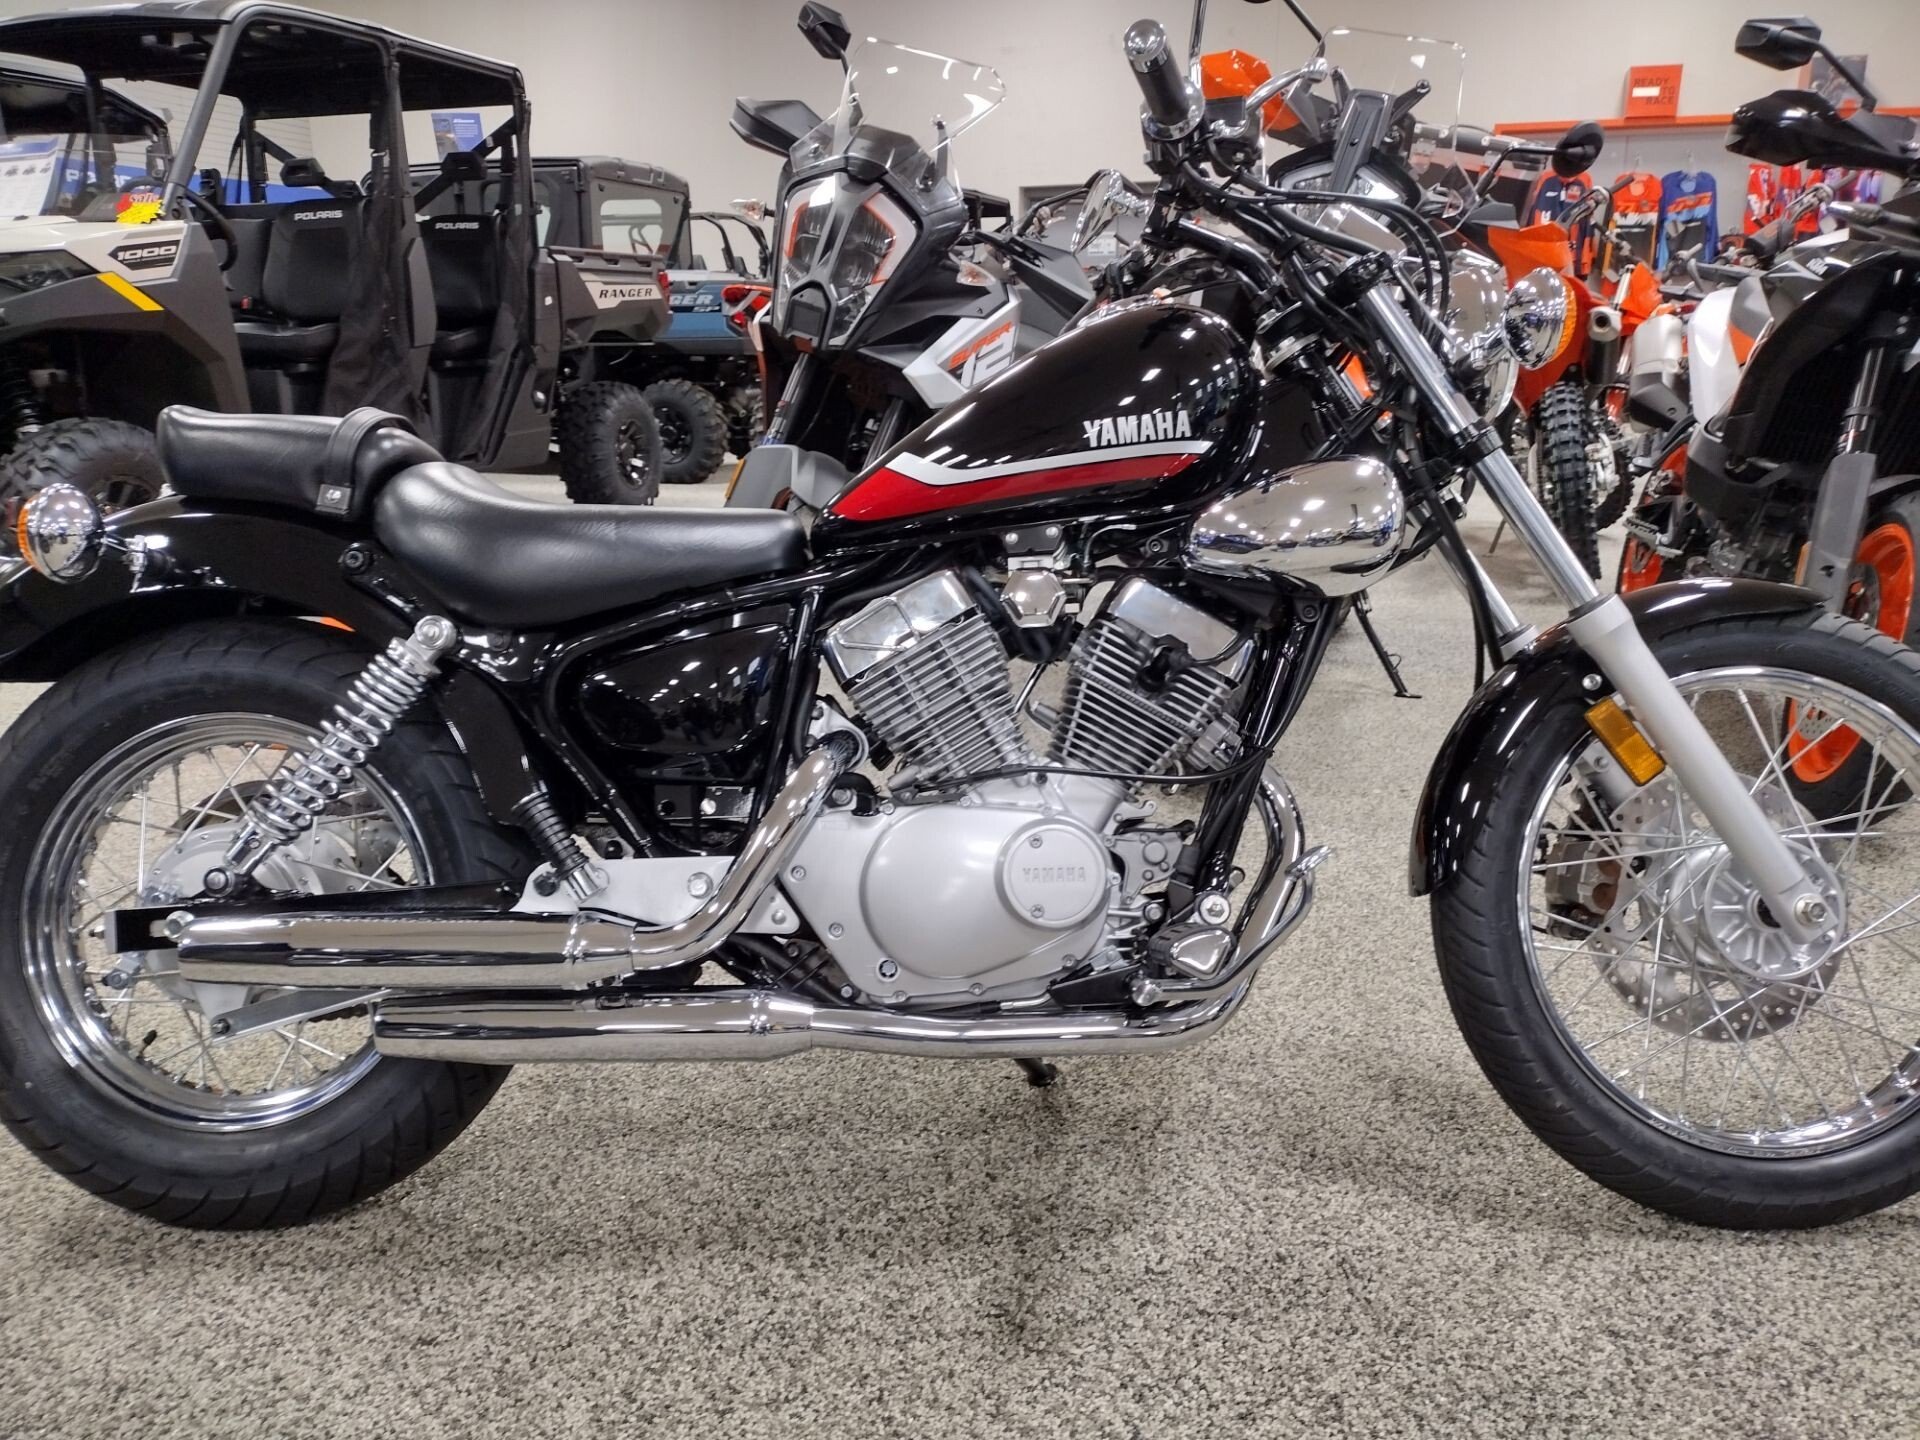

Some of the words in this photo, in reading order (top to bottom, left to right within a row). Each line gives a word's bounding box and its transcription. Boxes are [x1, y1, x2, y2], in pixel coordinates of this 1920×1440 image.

[1634, 77, 1670, 86] READY
[1662, 86, 1675, 95] TO
[1646, 96, 1674, 105] RACE
[294, 210, 343, 221] POLARIS
[435, 221, 479, 230] POLARIS
[117, 245, 177, 260] 1000
[599, 287, 653, 299] RANGER
[948, 321, 1012, 369] SUPER
[1083, 410, 1192, 448] YAMAHA
[1023, 866, 1087, 883] YAMAHA
